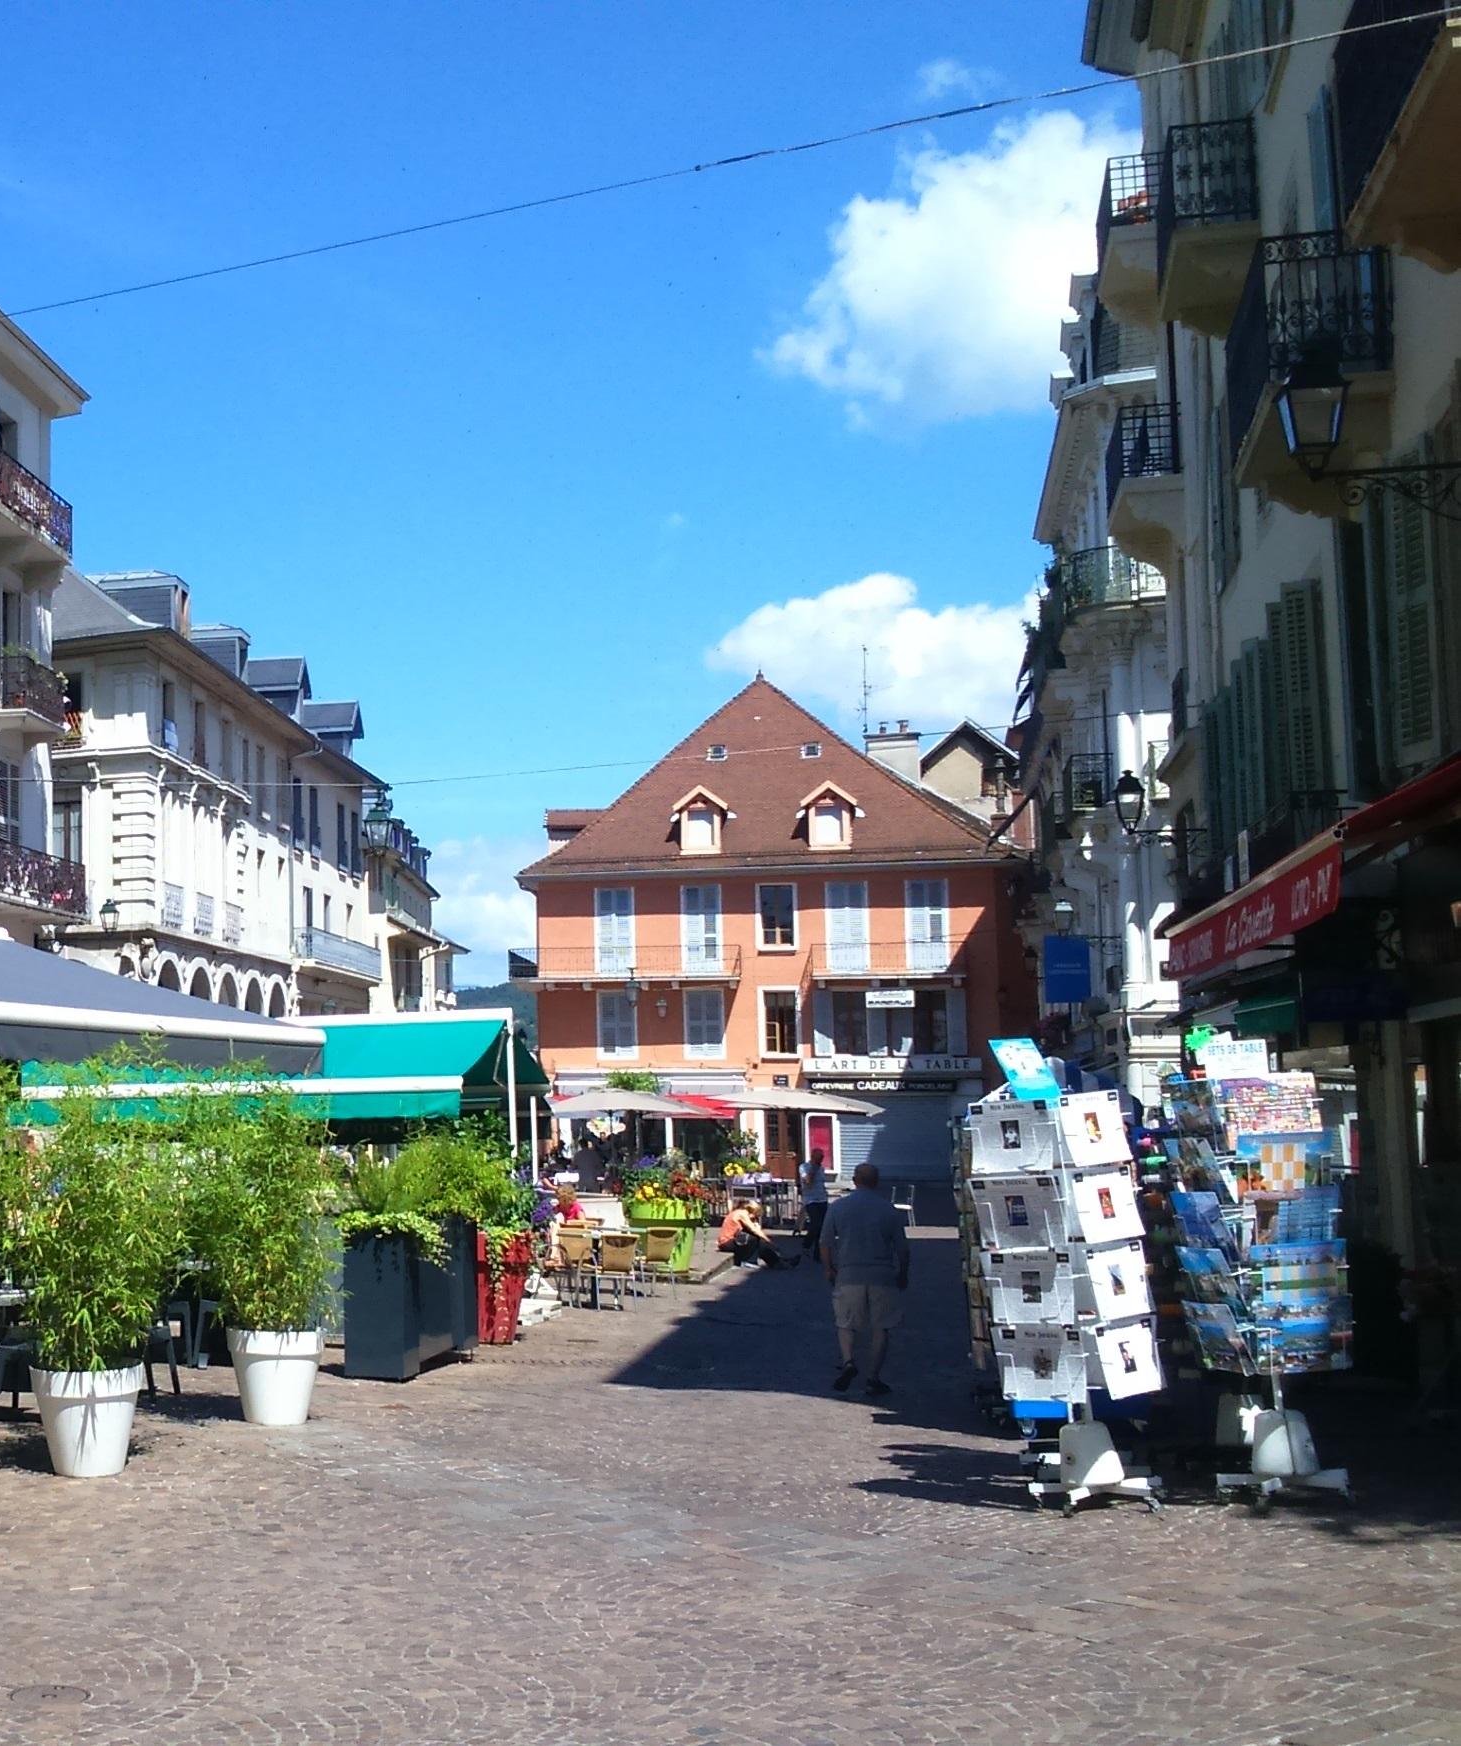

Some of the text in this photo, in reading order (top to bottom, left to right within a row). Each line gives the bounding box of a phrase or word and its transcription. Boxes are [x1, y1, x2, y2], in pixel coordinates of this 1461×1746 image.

[1224, 914, 1238, 955] La
[1290, 875, 1310, 921] LOTO
[1227, 1044, 1237, 1055] DE
[1238, 1042, 1263, 1054] TABLE
[869, 1059, 886, 1070] DE
[898, 1059, 914, 1070] LA
[925, 1059, 971, 1070] TABLE
[856, 1080, 906, 1091] CADEAUX
